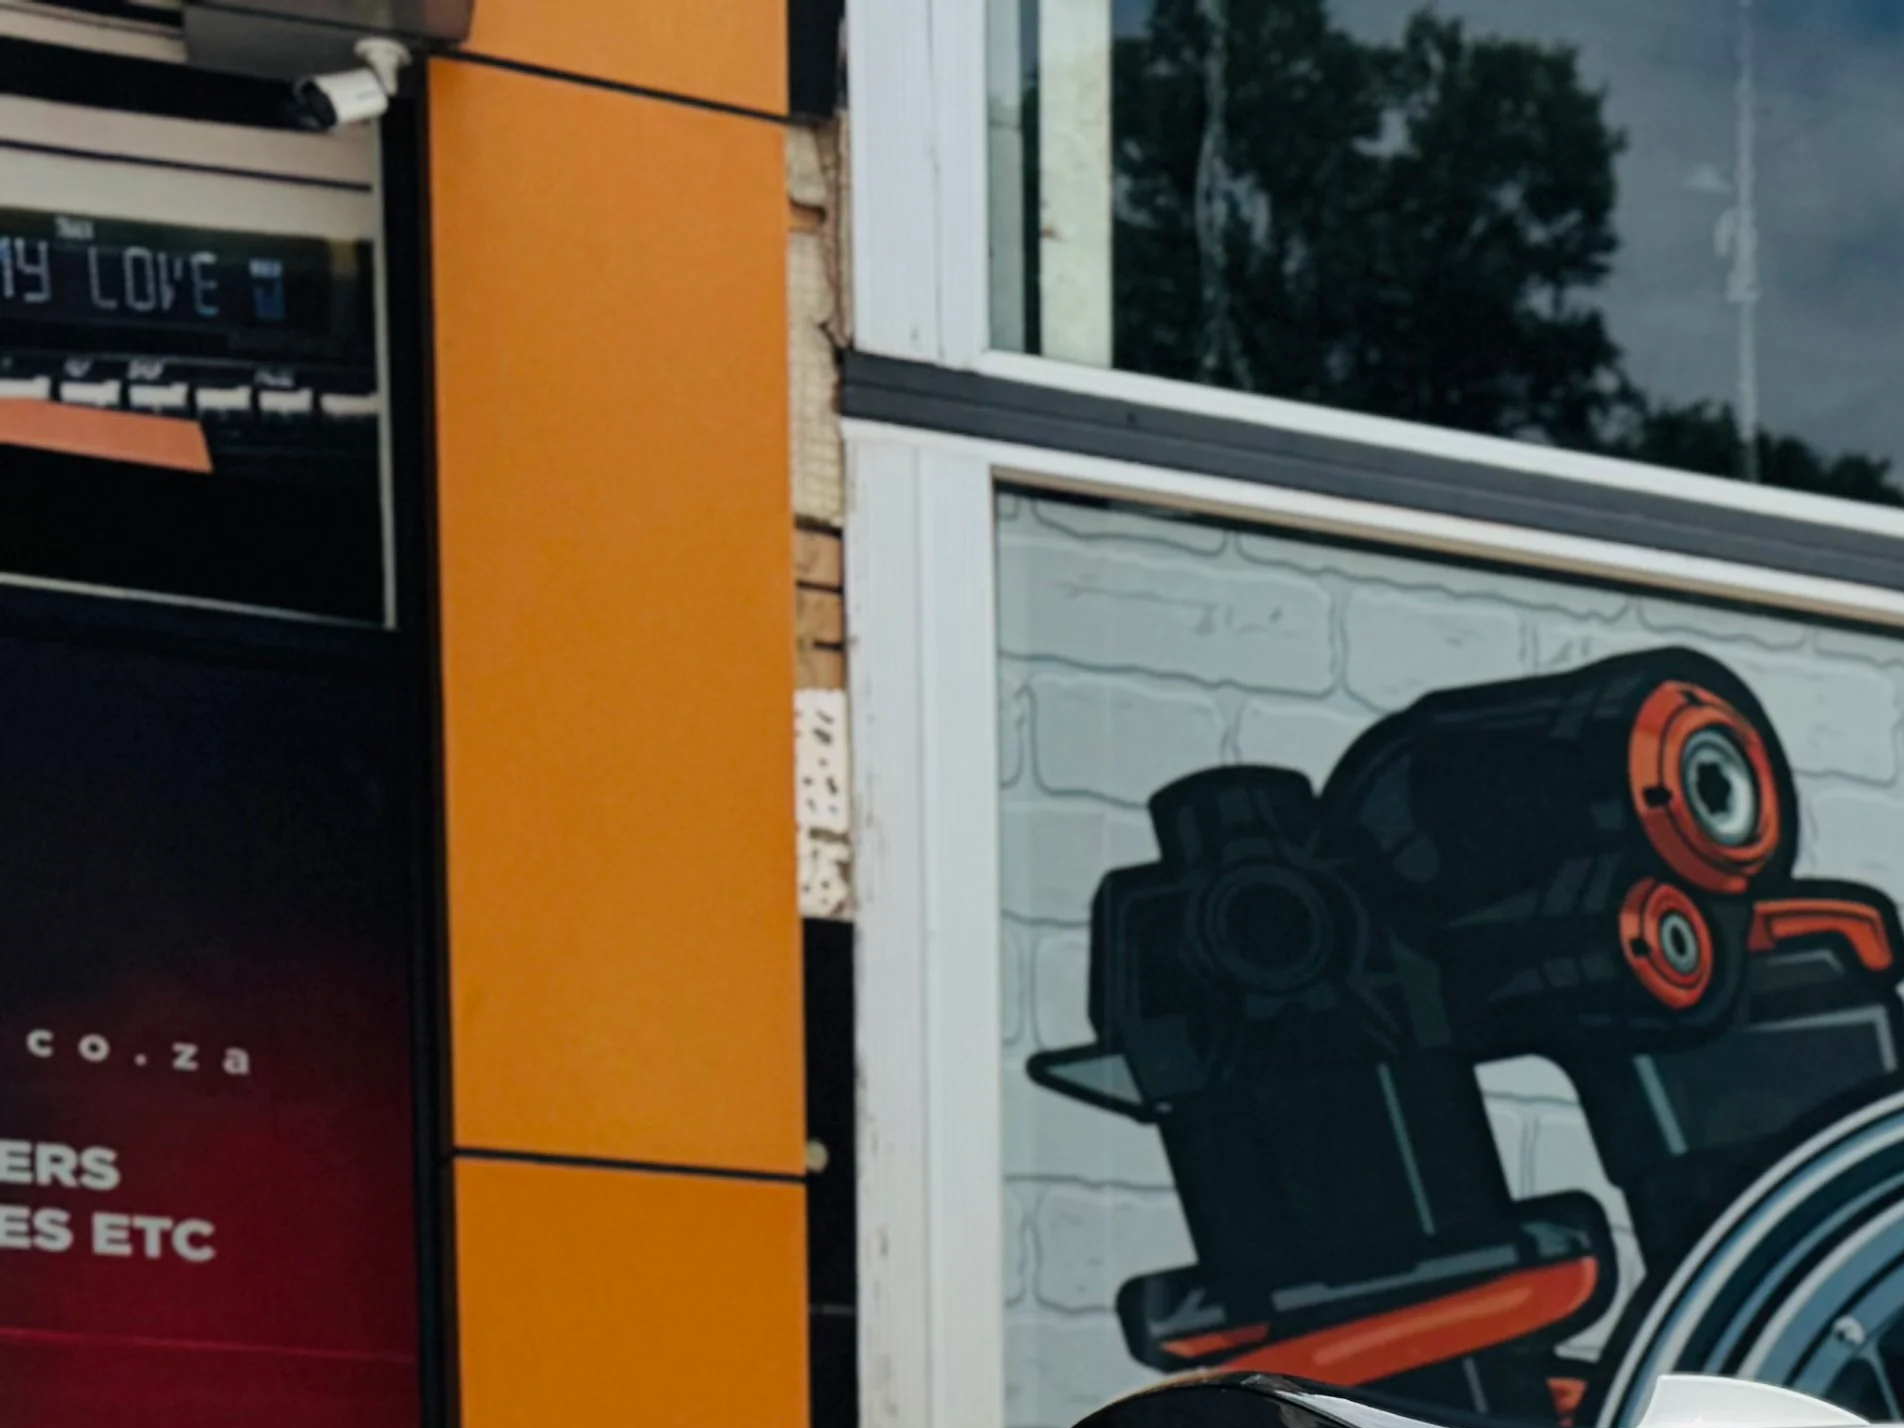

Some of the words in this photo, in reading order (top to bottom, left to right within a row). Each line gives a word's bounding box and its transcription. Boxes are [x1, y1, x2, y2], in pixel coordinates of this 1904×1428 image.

[87, 246, 221, 317] LOVE
[0, 1138, 121, 1191] ERS
[0, 1203, 74, 1252] ES
[92, 1211, 217, 1263] ETC
